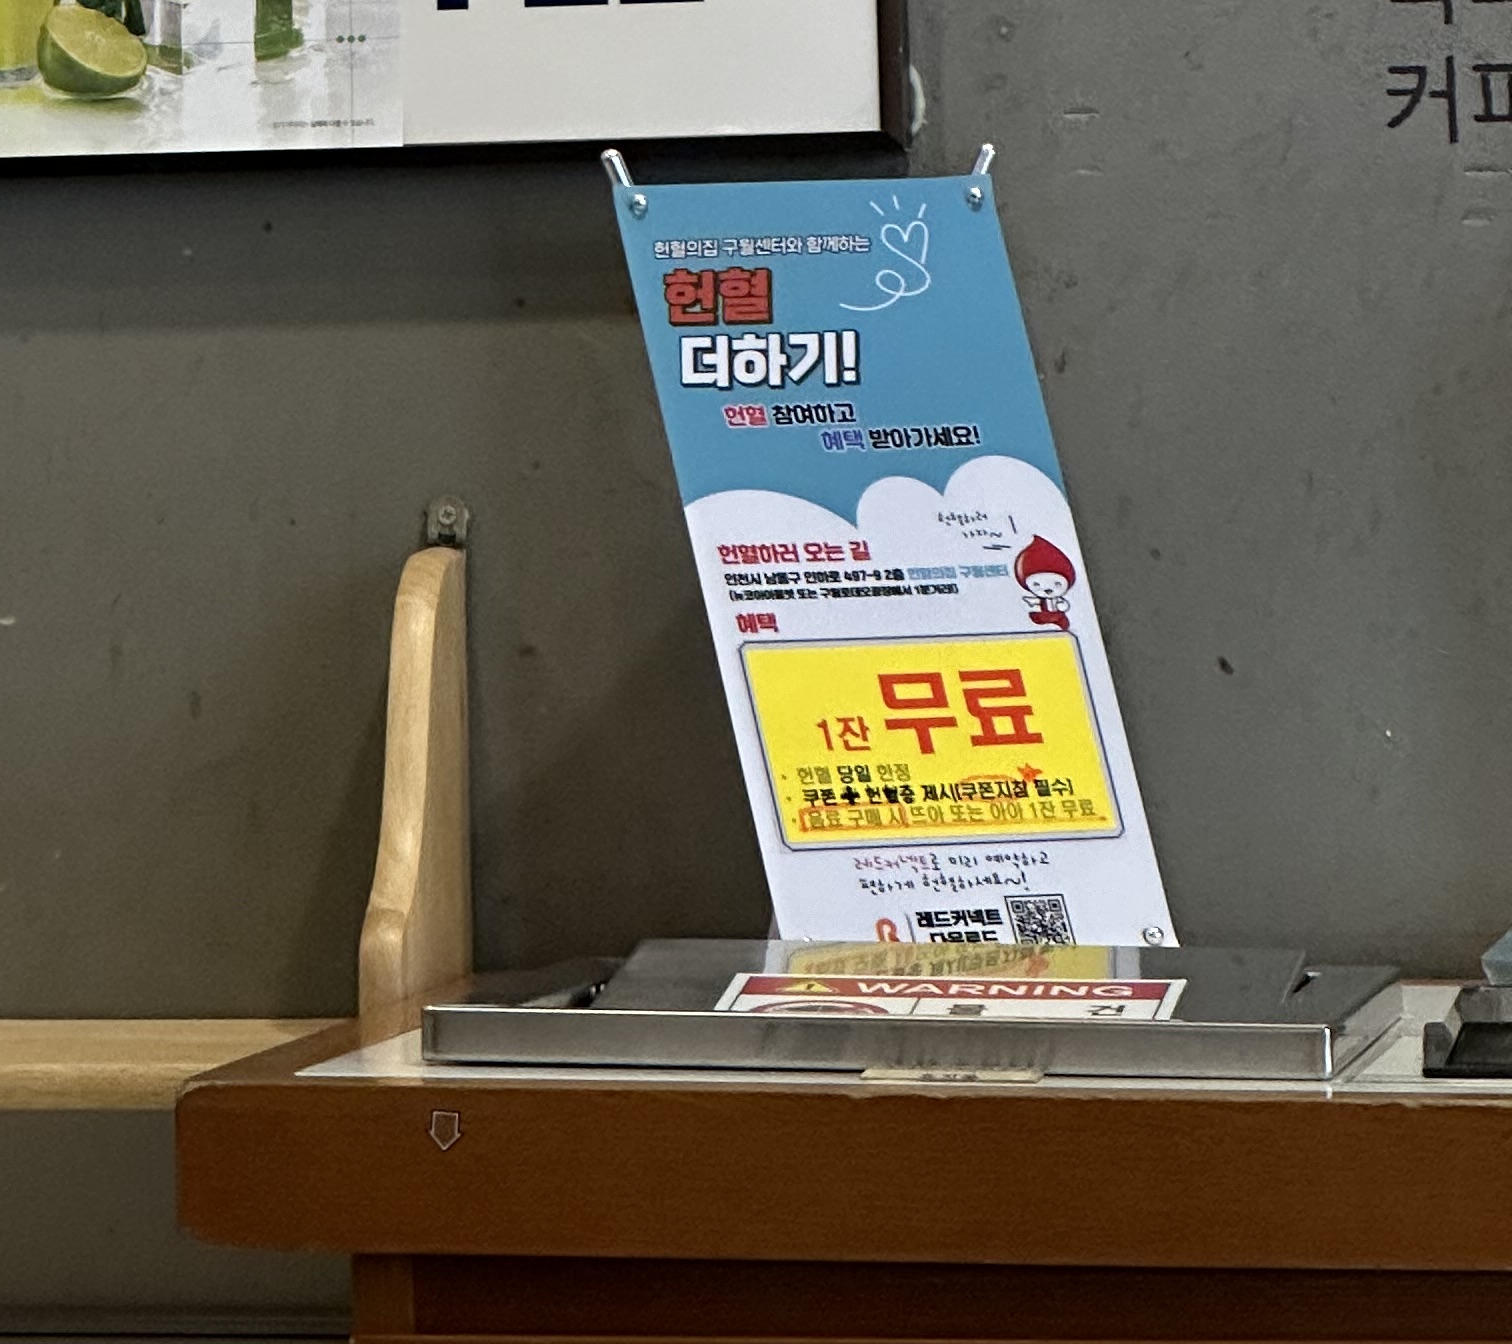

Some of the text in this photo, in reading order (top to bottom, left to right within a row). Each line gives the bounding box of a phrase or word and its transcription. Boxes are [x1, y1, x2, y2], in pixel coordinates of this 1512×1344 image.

[653, 233, 871, 260] 헌혈의집 구월센터와 함께하는
[663, 265, 774, 327] 헌혈
[679, 328, 862, 390] 더하기!
[723, 402, 857, 428] 헌혈 참여하고
[821, 424, 981, 453] 혜택 받아가세요!
[803, 542, 845, 563] 오는
[848, 540, 871, 562] 길
[816, 668, 1045, 756] 1잔 무료
[796, 765, 832, 785] 헌혈
[837, 764, 872, 784] 당일
[802, 787, 837, 806] 쿠폰
[864, 784, 916, 805] 헌혈증
[949, 803, 986, 823] 또는
[989, 800, 1025, 820] 아아
[1029, 799, 1057, 819] 1잔
[1061, 798, 1097, 817] 무료
[856, 981, 1134, 998] WARNING
